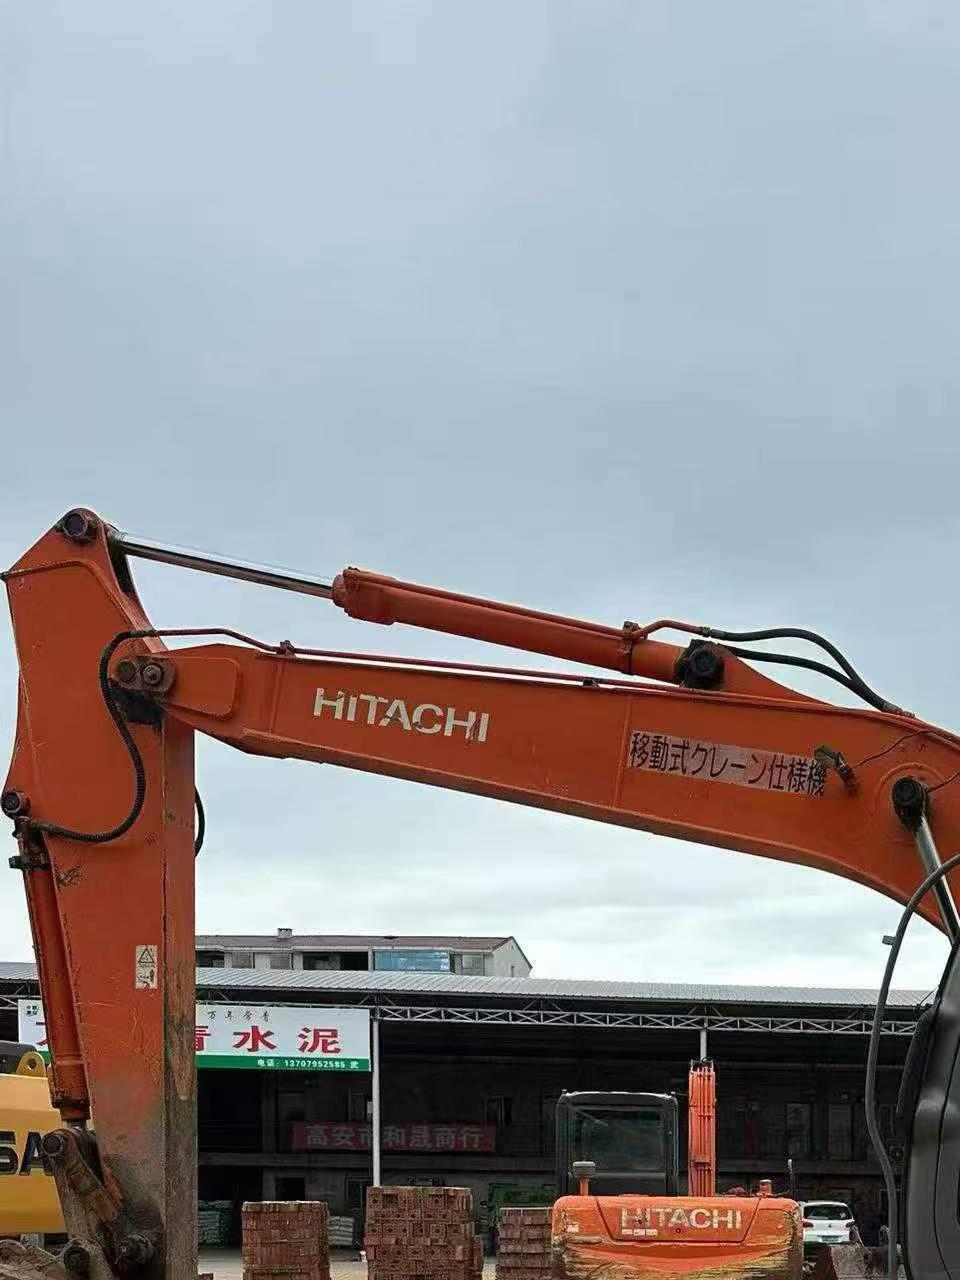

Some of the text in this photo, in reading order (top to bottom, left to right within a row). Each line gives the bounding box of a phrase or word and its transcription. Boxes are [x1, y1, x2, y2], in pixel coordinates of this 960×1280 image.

[314, 687, 489, 742] HITACHI
[630, 732, 827, 796] 移動式クレーン仕様機
[621, 1207, 742, 1230] HITACHI
